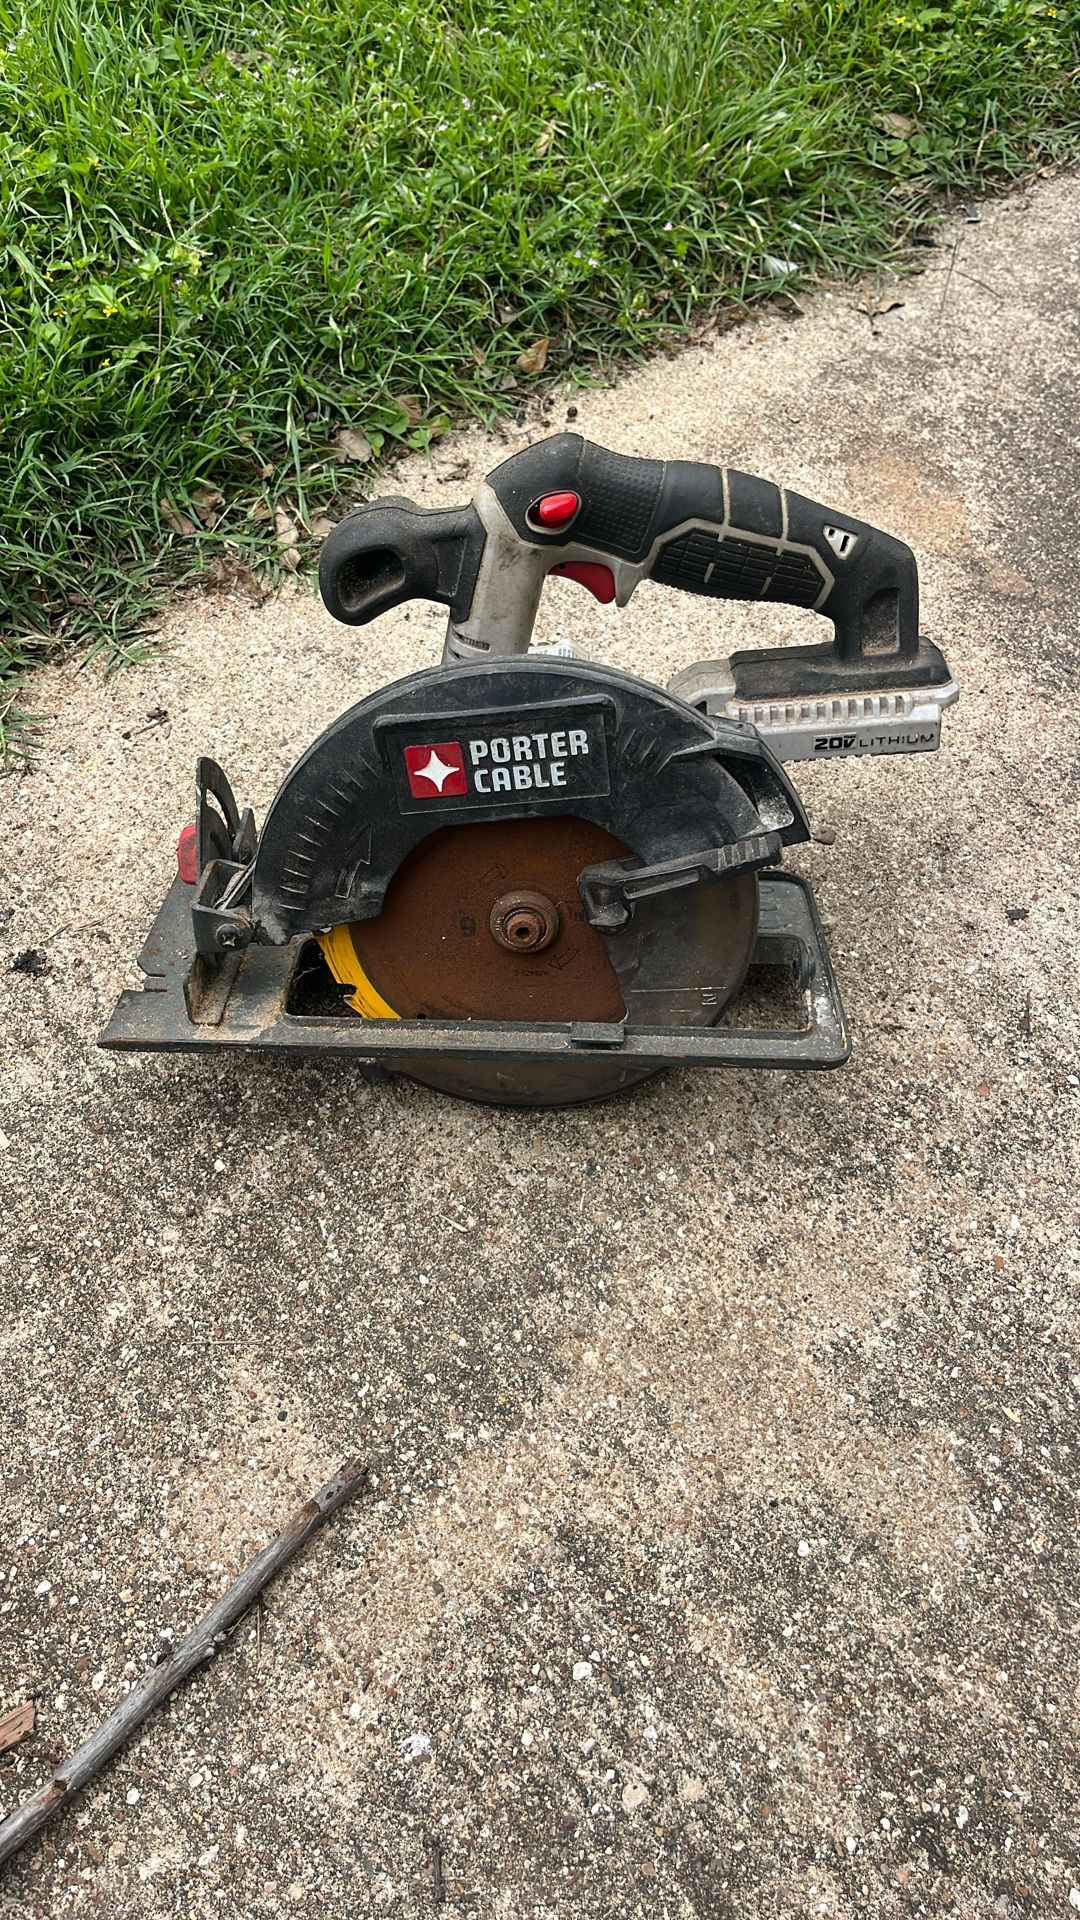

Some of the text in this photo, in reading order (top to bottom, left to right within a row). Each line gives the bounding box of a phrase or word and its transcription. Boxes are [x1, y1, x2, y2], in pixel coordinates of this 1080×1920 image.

[469, 729, 589, 766] PORTER
[859, 732, 934, 747] LITHIUM
[473, 761, 567, 793] CABLE
